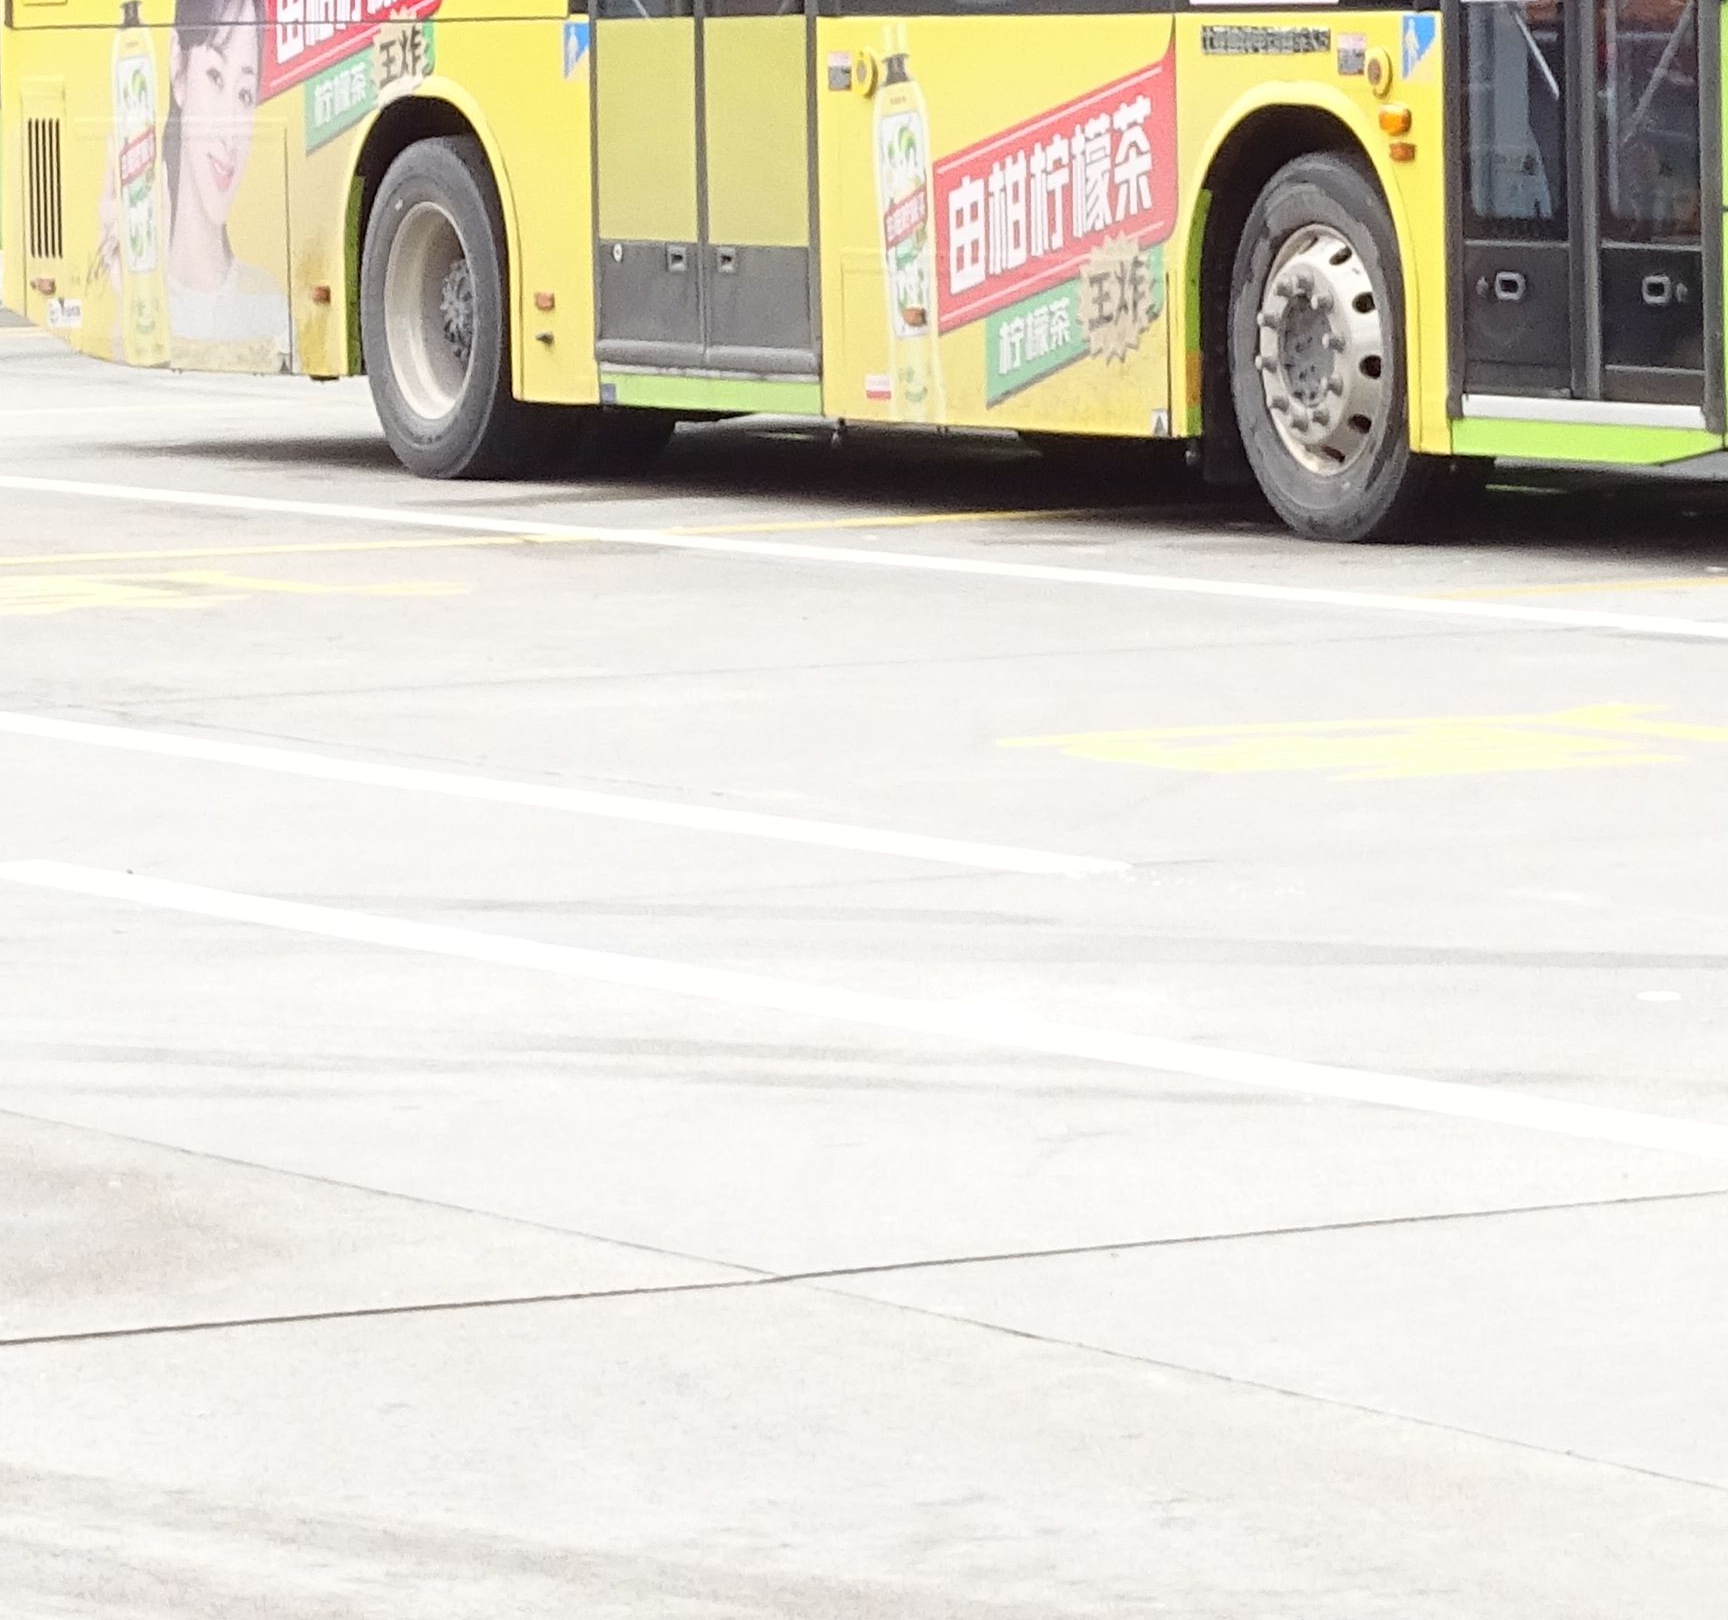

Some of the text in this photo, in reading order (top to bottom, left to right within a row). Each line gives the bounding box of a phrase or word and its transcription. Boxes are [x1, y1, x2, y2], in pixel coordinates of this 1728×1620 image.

[948, 93, 1153, 295] 由柑柠檬茶
[997, 296, 1070, 375] 柠檬茶
